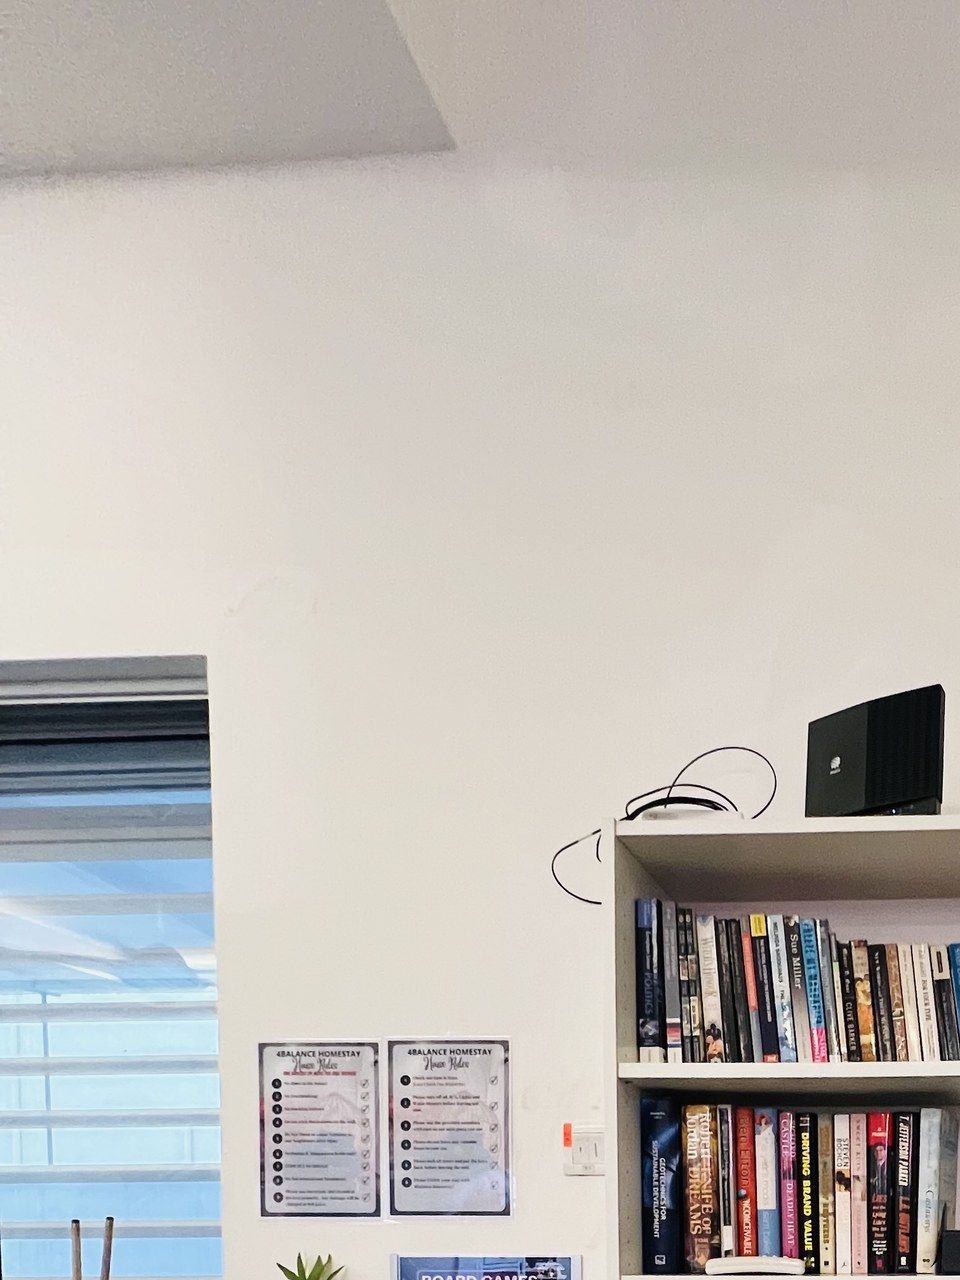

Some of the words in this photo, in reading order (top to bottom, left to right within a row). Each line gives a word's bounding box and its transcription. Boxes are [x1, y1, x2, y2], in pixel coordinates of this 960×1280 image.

[790, 934, 799, 954] Sue
[792, 957, 802, 989] Miller
[644, 972, 654, 1014] POLITICS
[845, 1002, 854, 1021] CLIVE
[407, 1048, 447, 1056] 4BALANCE
[847, 1024, 857, 1051] BARKER
[292, 1057, 314, 1073] House
[317, 1058, 337, 1073] Rules
[424, 1056, 446, 1071] House
[449, 1057, 470, 1071] Rules
[686, 1112, 700, 1159] Jordan
[699, 1113, 714, 1158] Robert
[739, 1117, 749, 1145] Ben
[781, 1119, 790, 1157] CASTLE
[899, 1122, 909, 1160] JEFFERSON
[652, 1140, 660, 1186] SUSTAINABLE
[740, 1149, 751, 1188] Elton
[801, 1132, 811, 1176] DRIVING
[700, 1167, 714, 1214] KNIFE
[898, 1160, 909, 1186] PARKER
[652, 1187, 660, 1238] DEVELOPMENT
[688, 1166, 702, 1235] DREAMS
[786, 1182, 794, 1219] DEADLY
[802, 1180, 811, 1216] BRAND
[702, 1217, 712, 1234] OF
[787, 1220, 795, 1246] HEAT
[804, 1219, 813, 1251] VALUE
